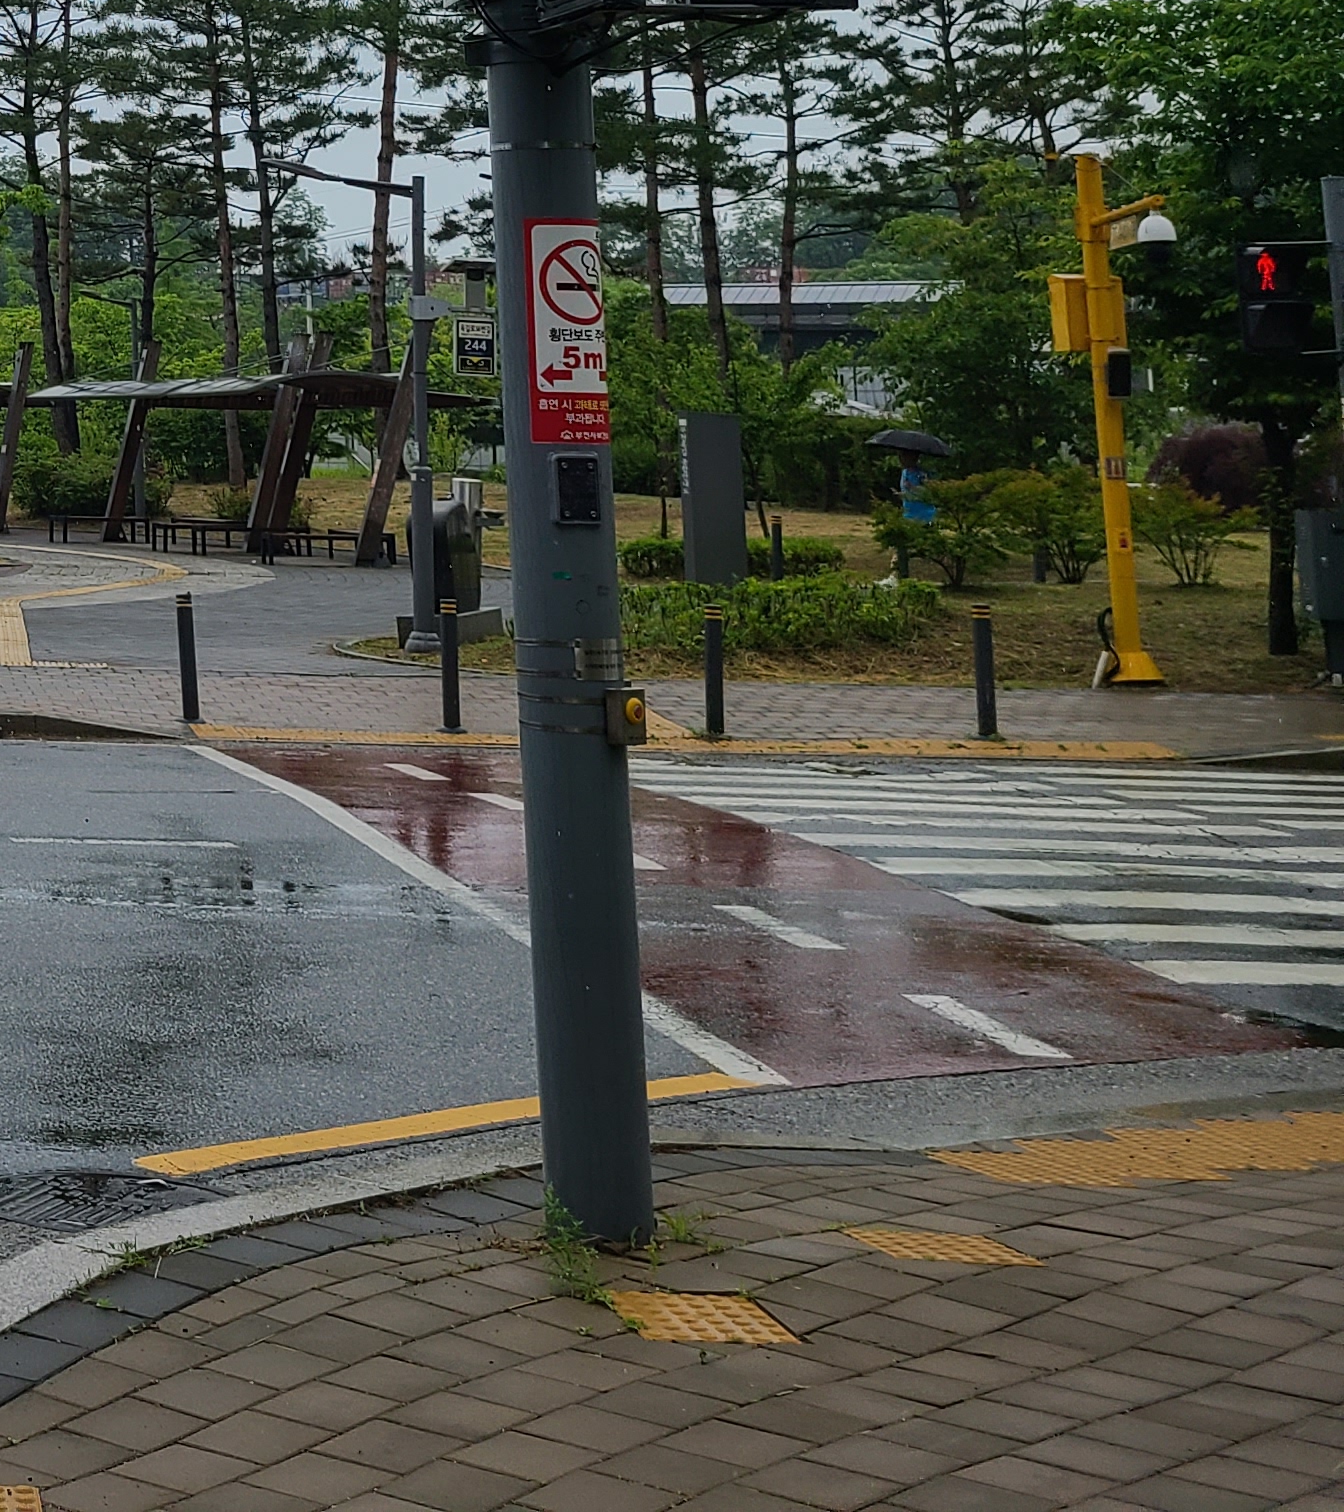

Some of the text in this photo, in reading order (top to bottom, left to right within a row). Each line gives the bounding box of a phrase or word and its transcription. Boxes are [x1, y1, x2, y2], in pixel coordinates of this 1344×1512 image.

[548, 327, 594, 343] 횡단보도
[464, 339, 488, 352] 244
[562, 345, 604, 370] 5m
[538, 398, 559, 411] 흡연
[561, 399, 572, 411] 시
